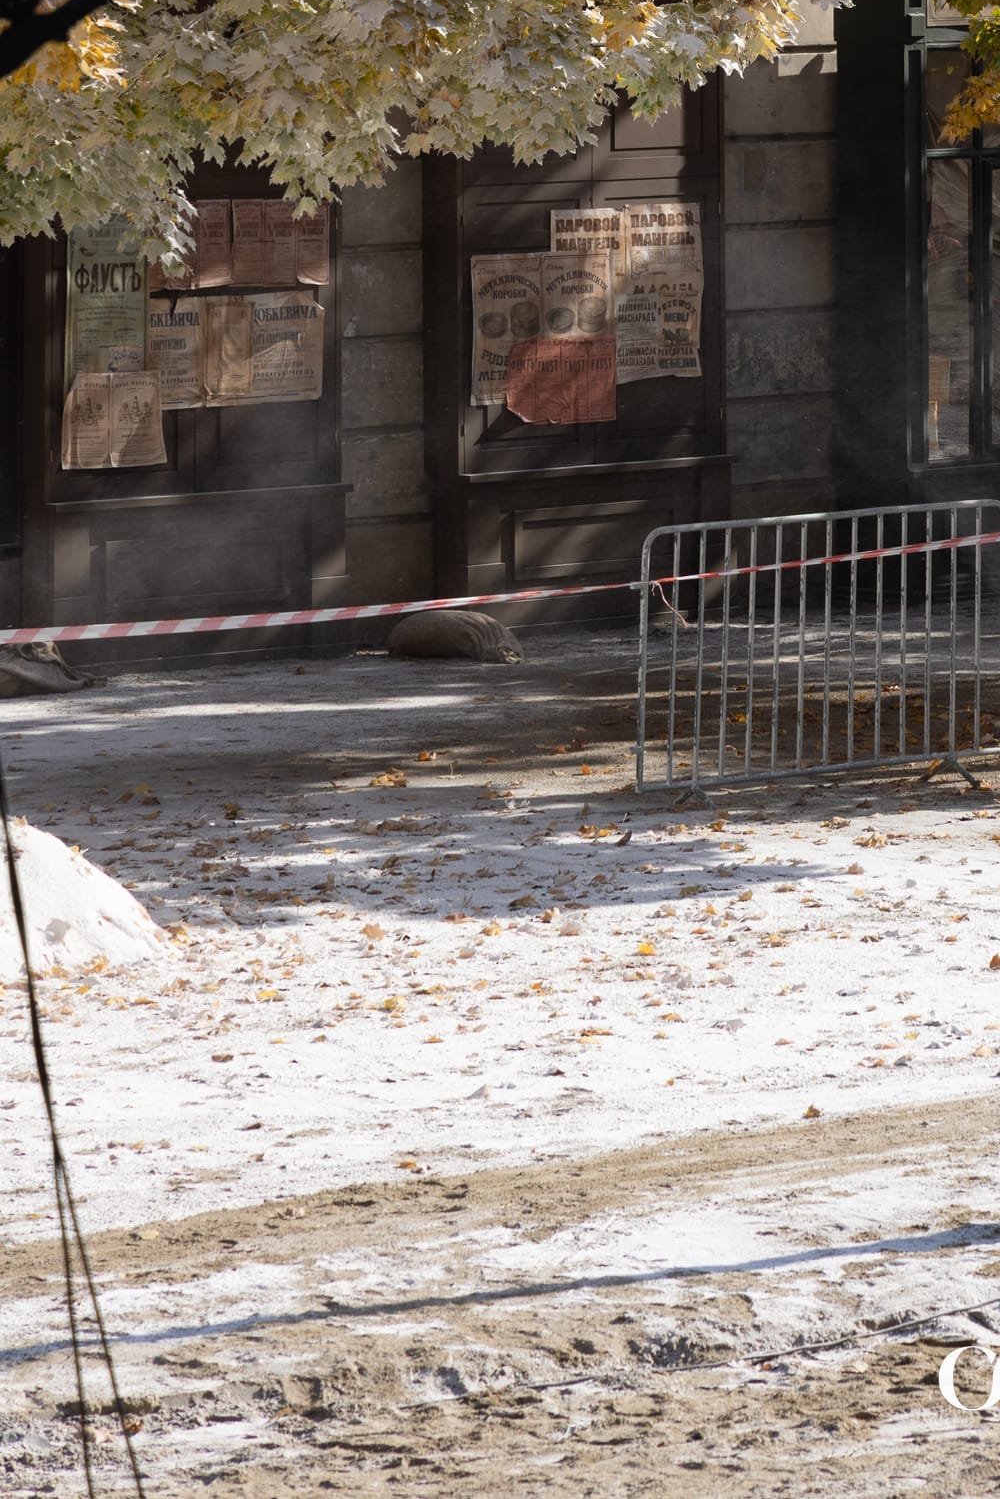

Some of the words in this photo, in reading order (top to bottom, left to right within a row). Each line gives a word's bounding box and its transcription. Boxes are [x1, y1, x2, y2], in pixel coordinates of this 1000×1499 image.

[555, 215, 620, 233] ПАРОВОЙ
[630, 210, 694, 228] ПАРОВОЙ
[555, 237, 620, 251] МАНГЕЛЬ
[631, 231, 695, 247] МАНГЕЛЬ
[74, 262, 142, 294] ФАУСТЪ
[493, 288, 528, 300] КОРОБКИ
[561, 283, 594, 296] КОРОБКИ
